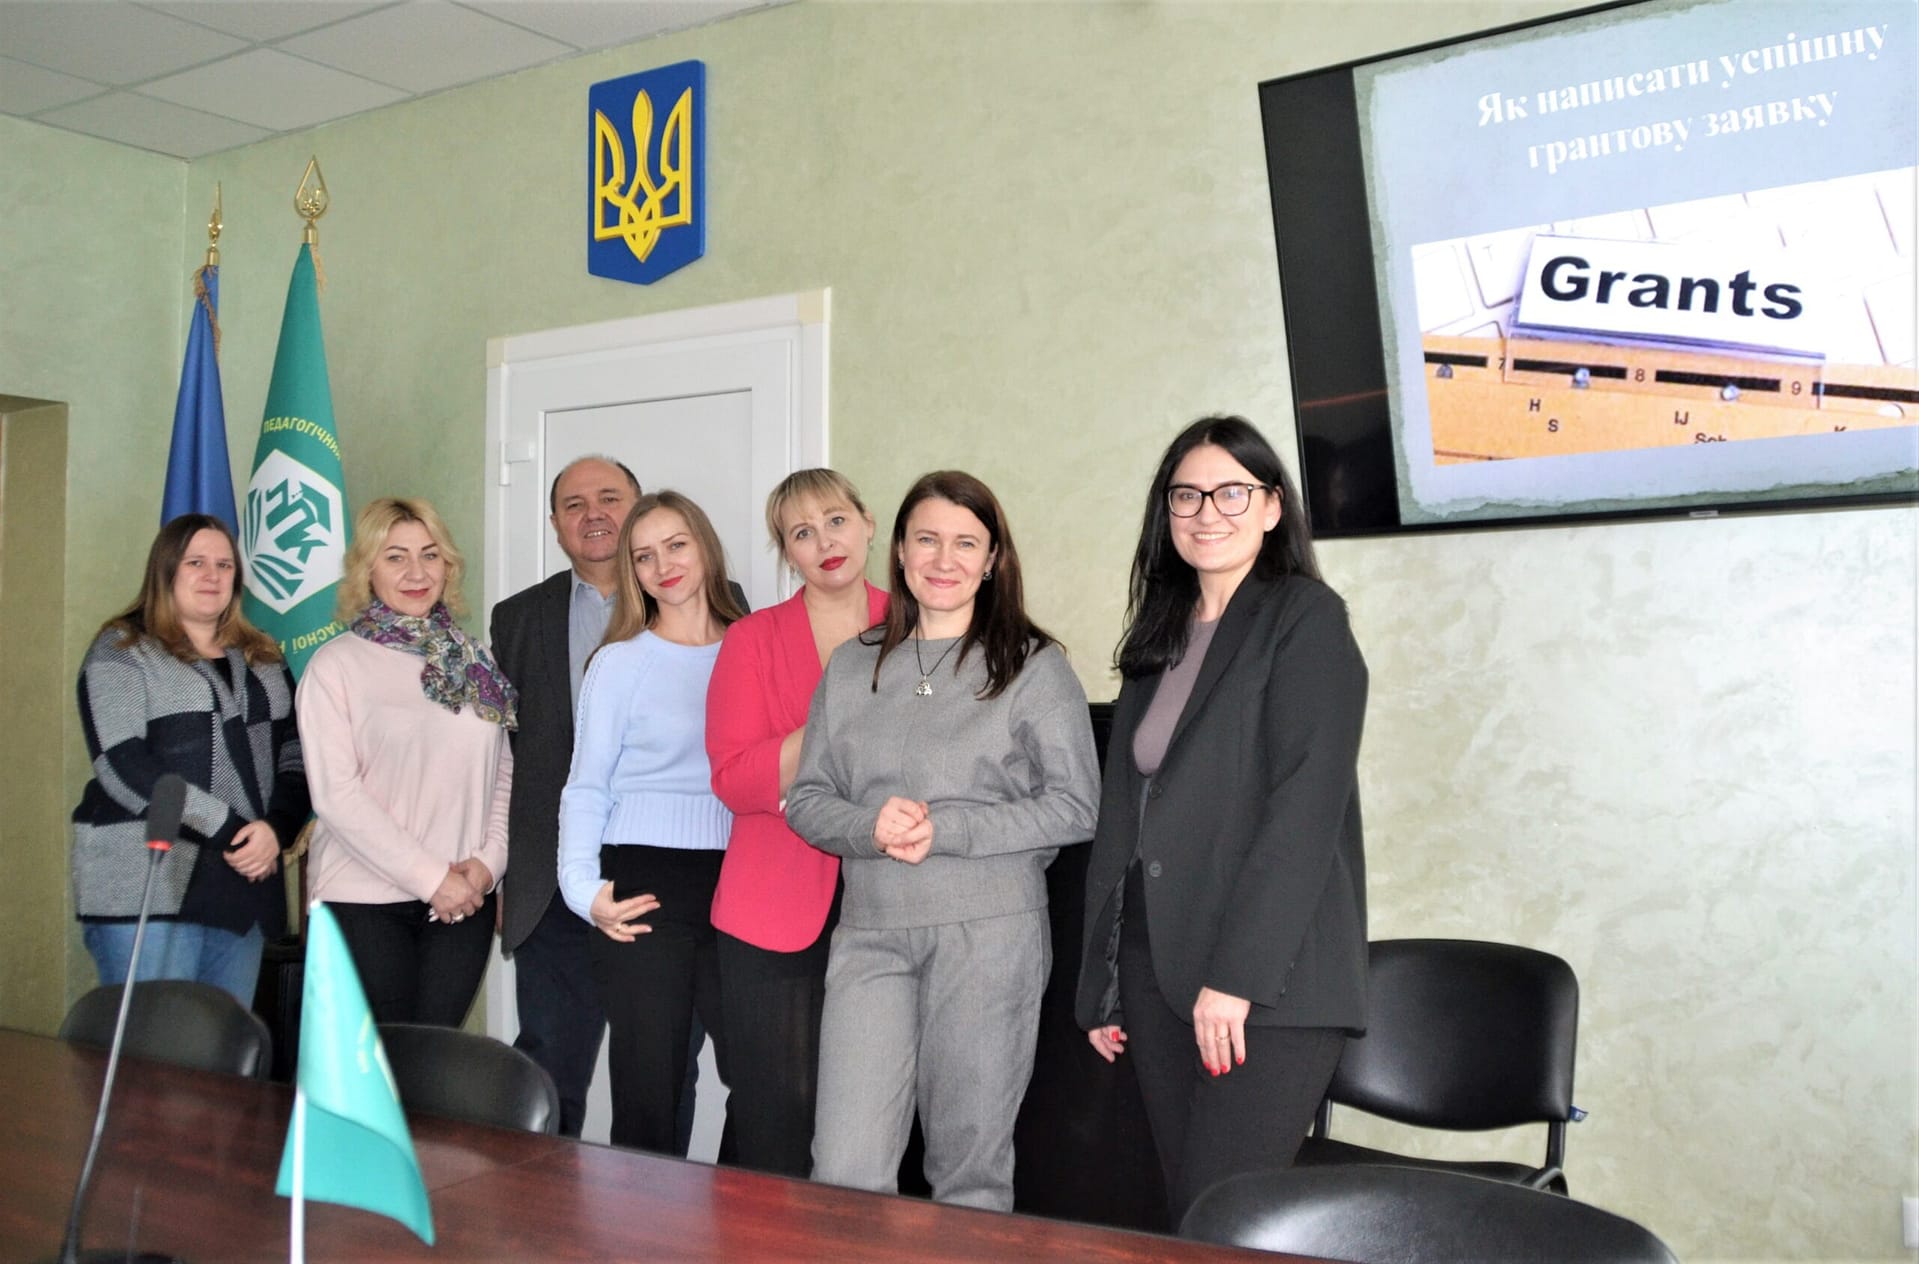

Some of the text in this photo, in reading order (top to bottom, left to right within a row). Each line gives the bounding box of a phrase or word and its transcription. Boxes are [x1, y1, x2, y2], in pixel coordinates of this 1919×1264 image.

[1478, 24, 1889, 127] Як написати успішну
[1528, 91, 1840, 175] грантову заявку
[1540, 255, 1804, 320] Grants
[1634, 368, 1646, 382] 8
[1791, 381, 1802, 395] 9
[1529, 398, 1541, 412] H
[1548, 419, 1559, 433] S
